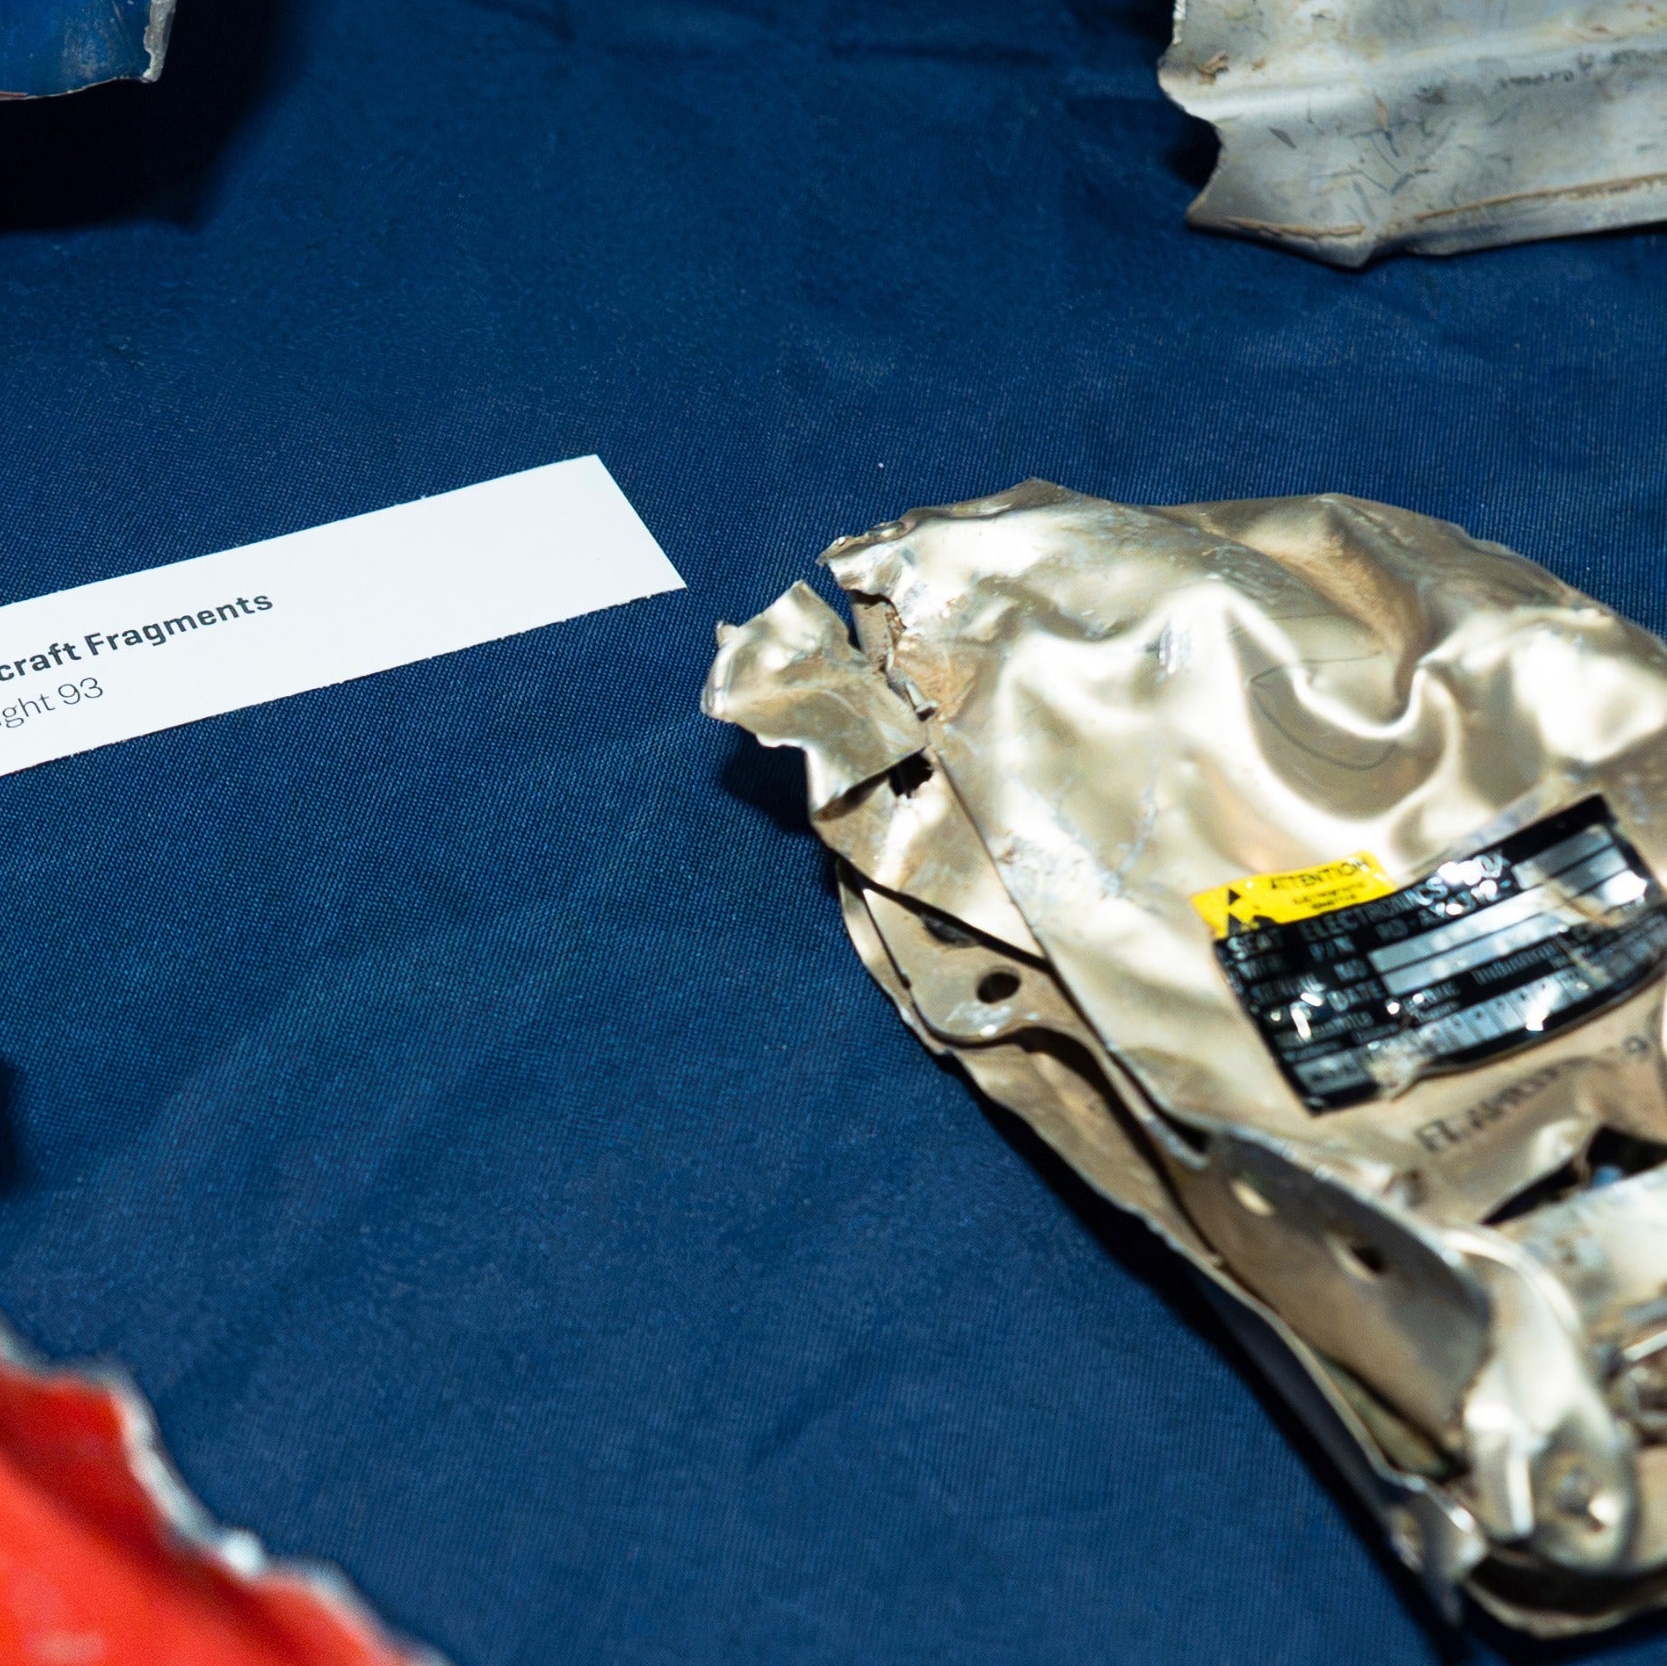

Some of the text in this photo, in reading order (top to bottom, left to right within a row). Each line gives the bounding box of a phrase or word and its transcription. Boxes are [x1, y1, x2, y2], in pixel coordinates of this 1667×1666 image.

[83, 594, 274, 657] Fragments
[56, 676, 104, 706] 93
[1268, 857, 1372, 890] ATTENTION
[1298, 877, 1449, 939] ELECTRONICS
